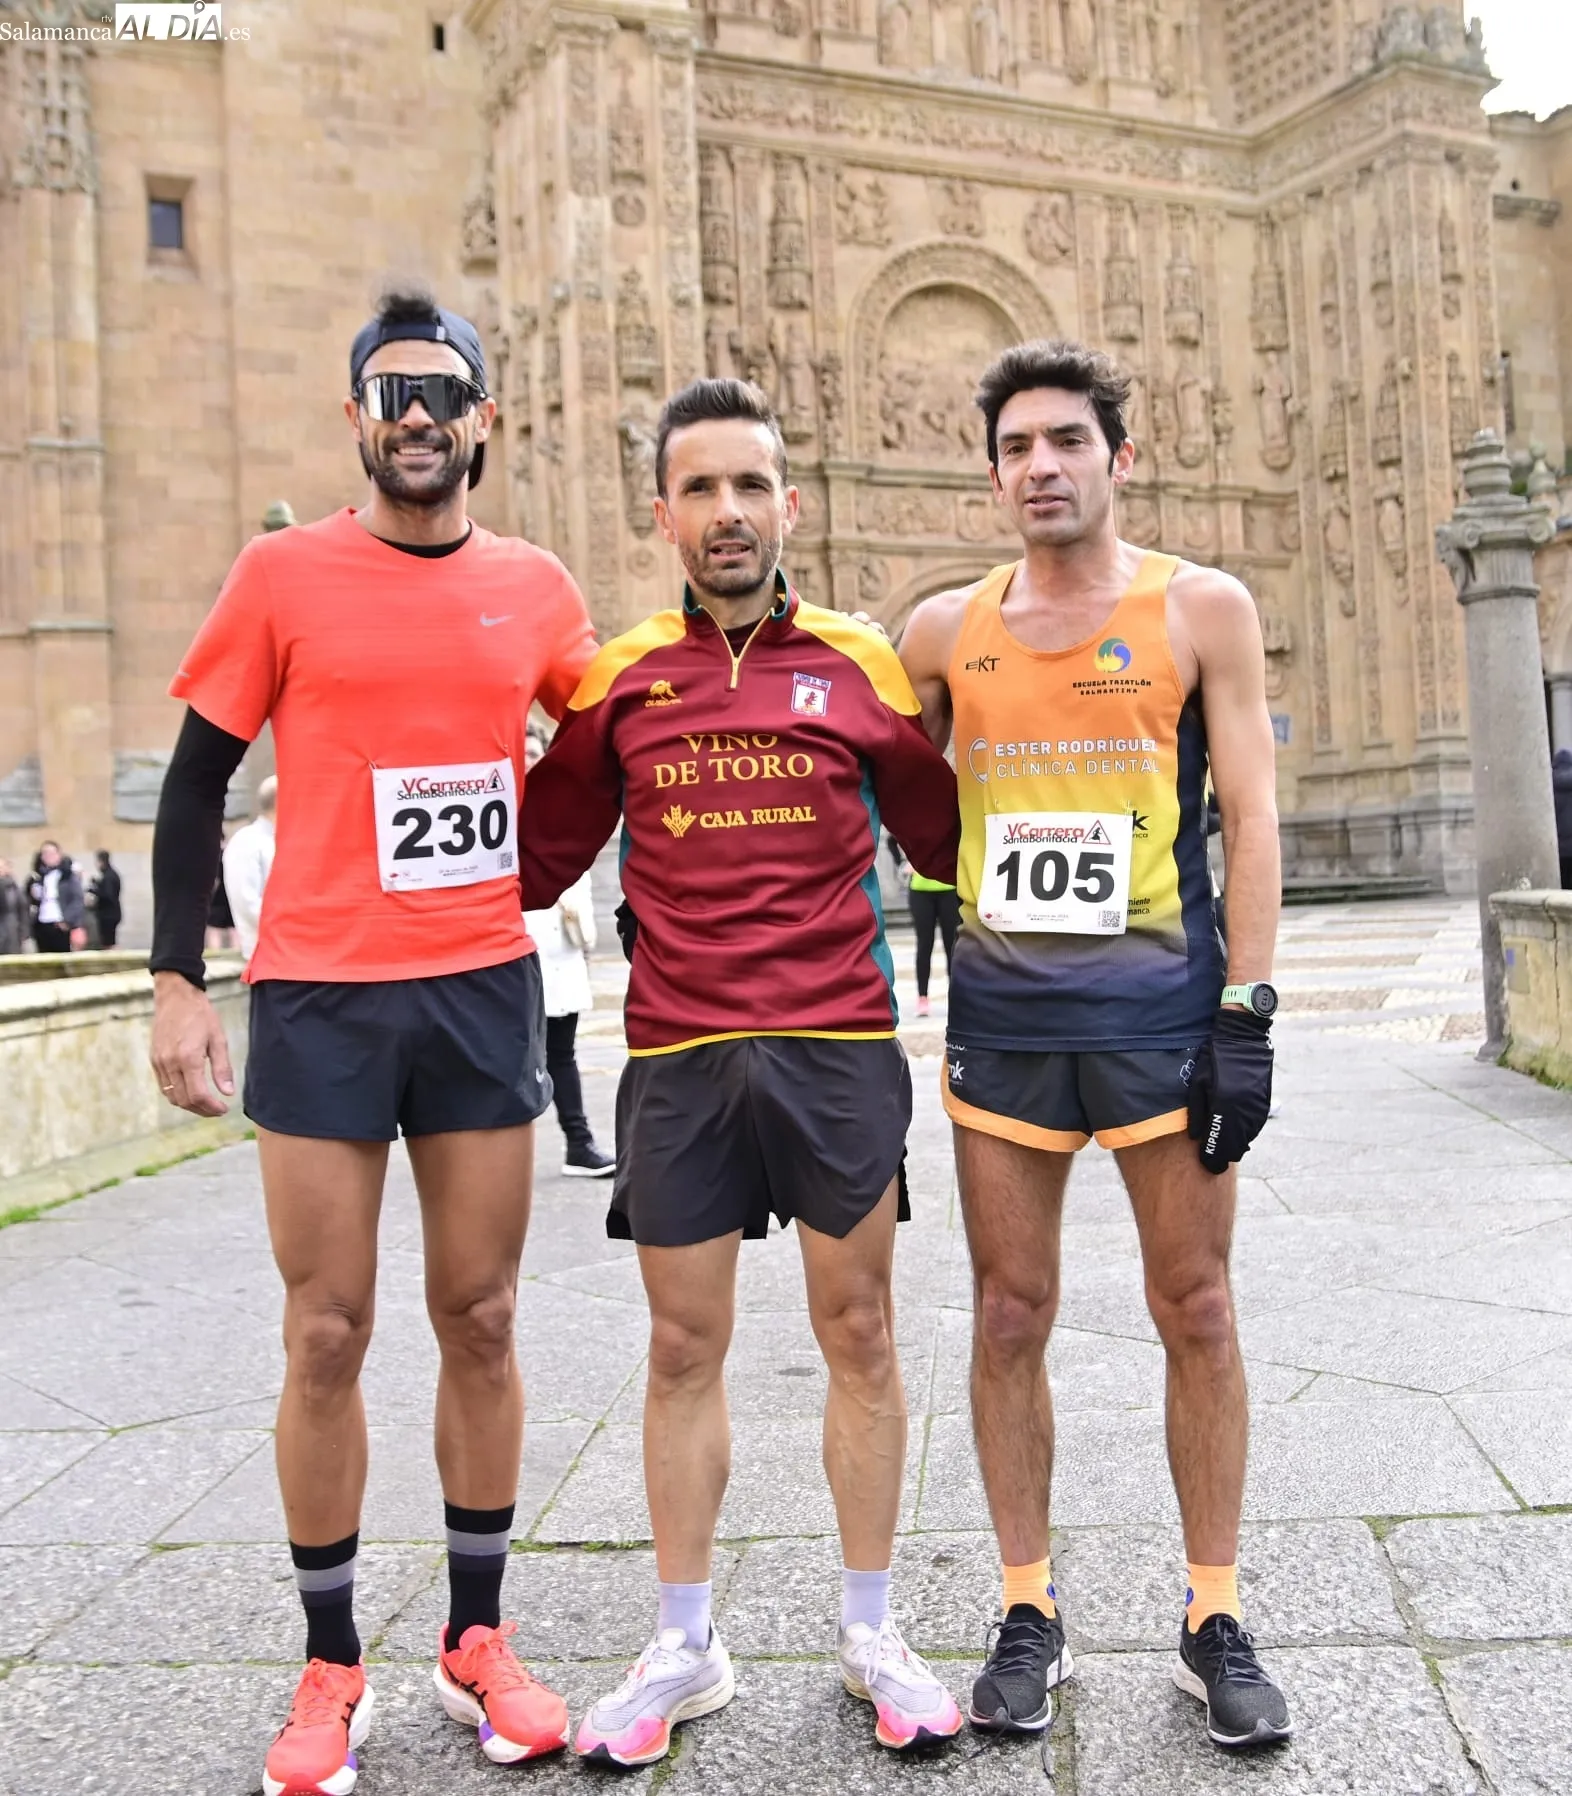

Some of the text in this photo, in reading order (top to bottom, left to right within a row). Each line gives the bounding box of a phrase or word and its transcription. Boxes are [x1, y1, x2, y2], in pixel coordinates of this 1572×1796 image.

[1072, 680, 1107, 689] ESCUELA
[1080, 688, 1138, 696] SALMANTINA
[995, 740, 1051, 757] ESTER
[653, 753, 814, 788] DE TORO
[996, 757, 1159, 778] CLÍNICA DENTAL
[700, 806, 817, 829] CAJA RURAL
[391, 799, 508, 860] 230
[996, 850, 1115, 904] 105
[1205, 1113, 1223, 1155] KIPRUN
